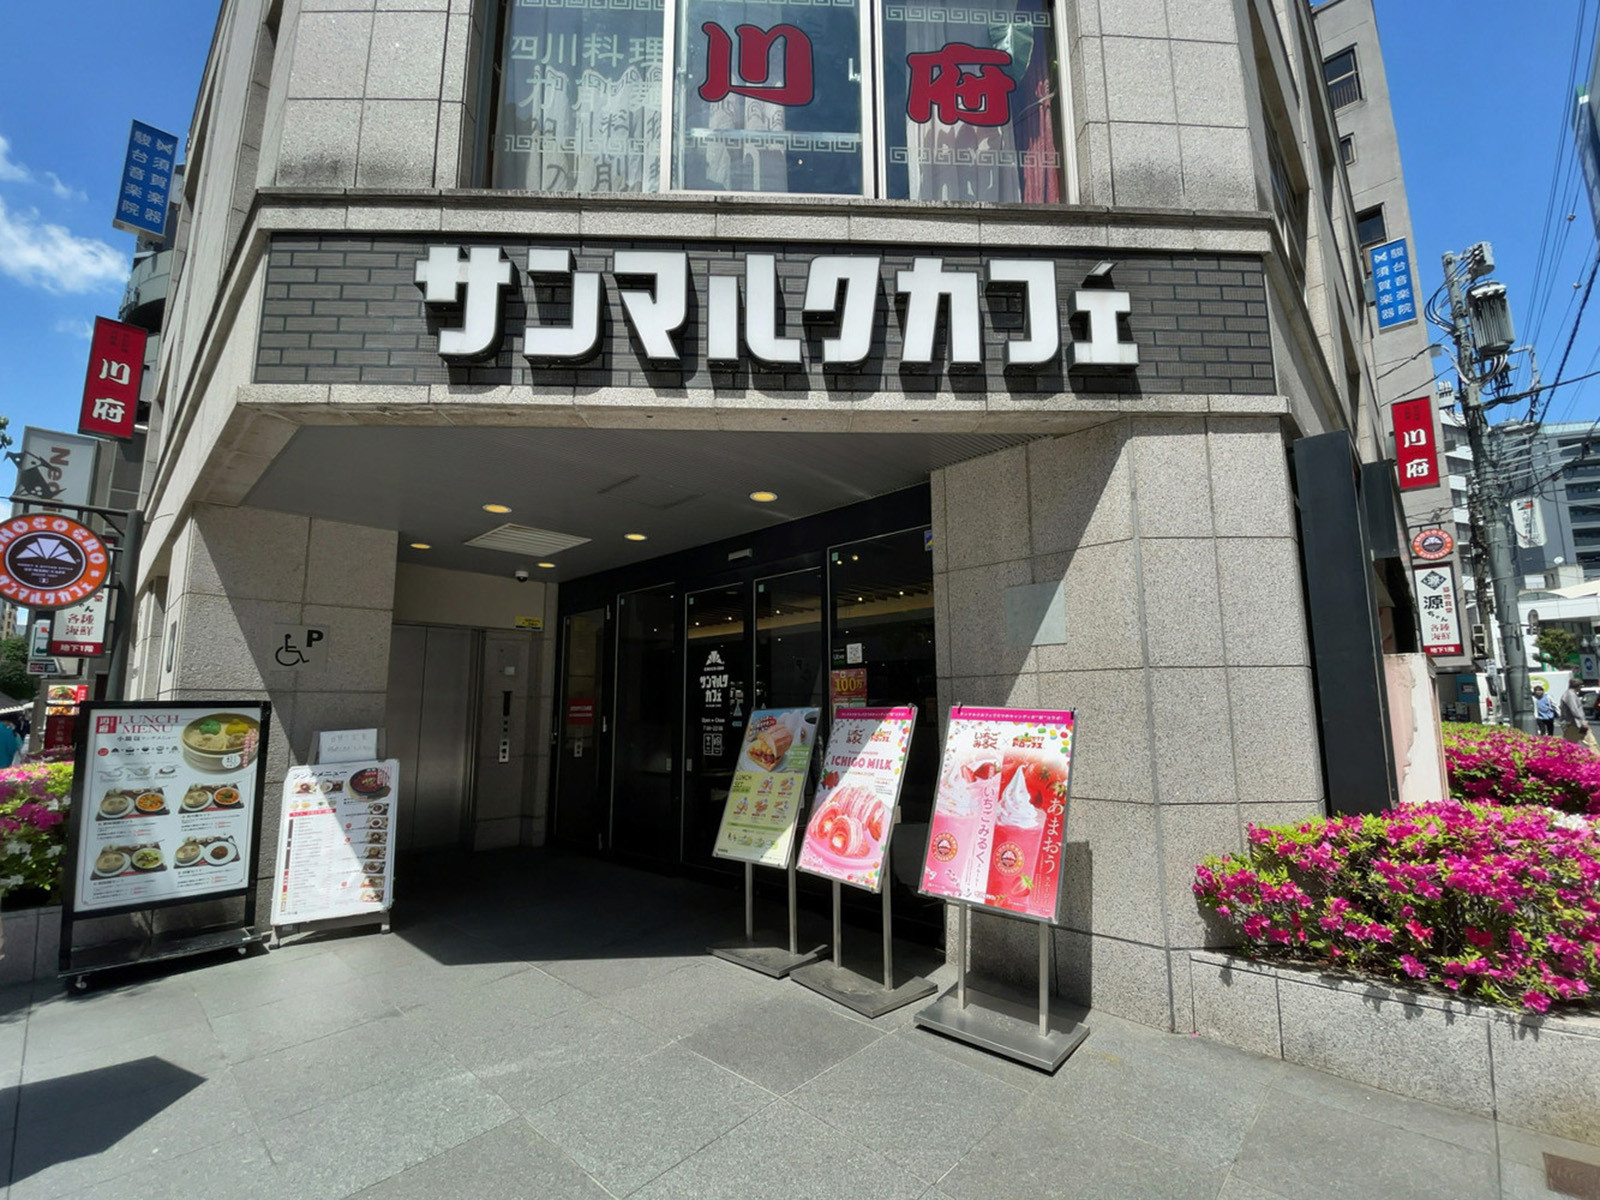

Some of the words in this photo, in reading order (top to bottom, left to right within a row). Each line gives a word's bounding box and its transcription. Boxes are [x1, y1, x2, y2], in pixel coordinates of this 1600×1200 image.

[512, 33, 663, 68] 四川料理
[144, 157, 170, 224] 須賀楽器
[414, 245, 1140, 369] サンマルクカフェ
[1376, 266, 1396, 320] 須賀楽器
[306, 629, 324, 648] P
[118, 714, 180, 725] LUNCH
[122, 725, 174, 734] MENU
[831, 755, 866, 768] ICHIGO
[867, 758, 893, 770] MILK
[975, 787, 995, 864] いちごみるく
[1041, 798, 1065, 875] あまおう
